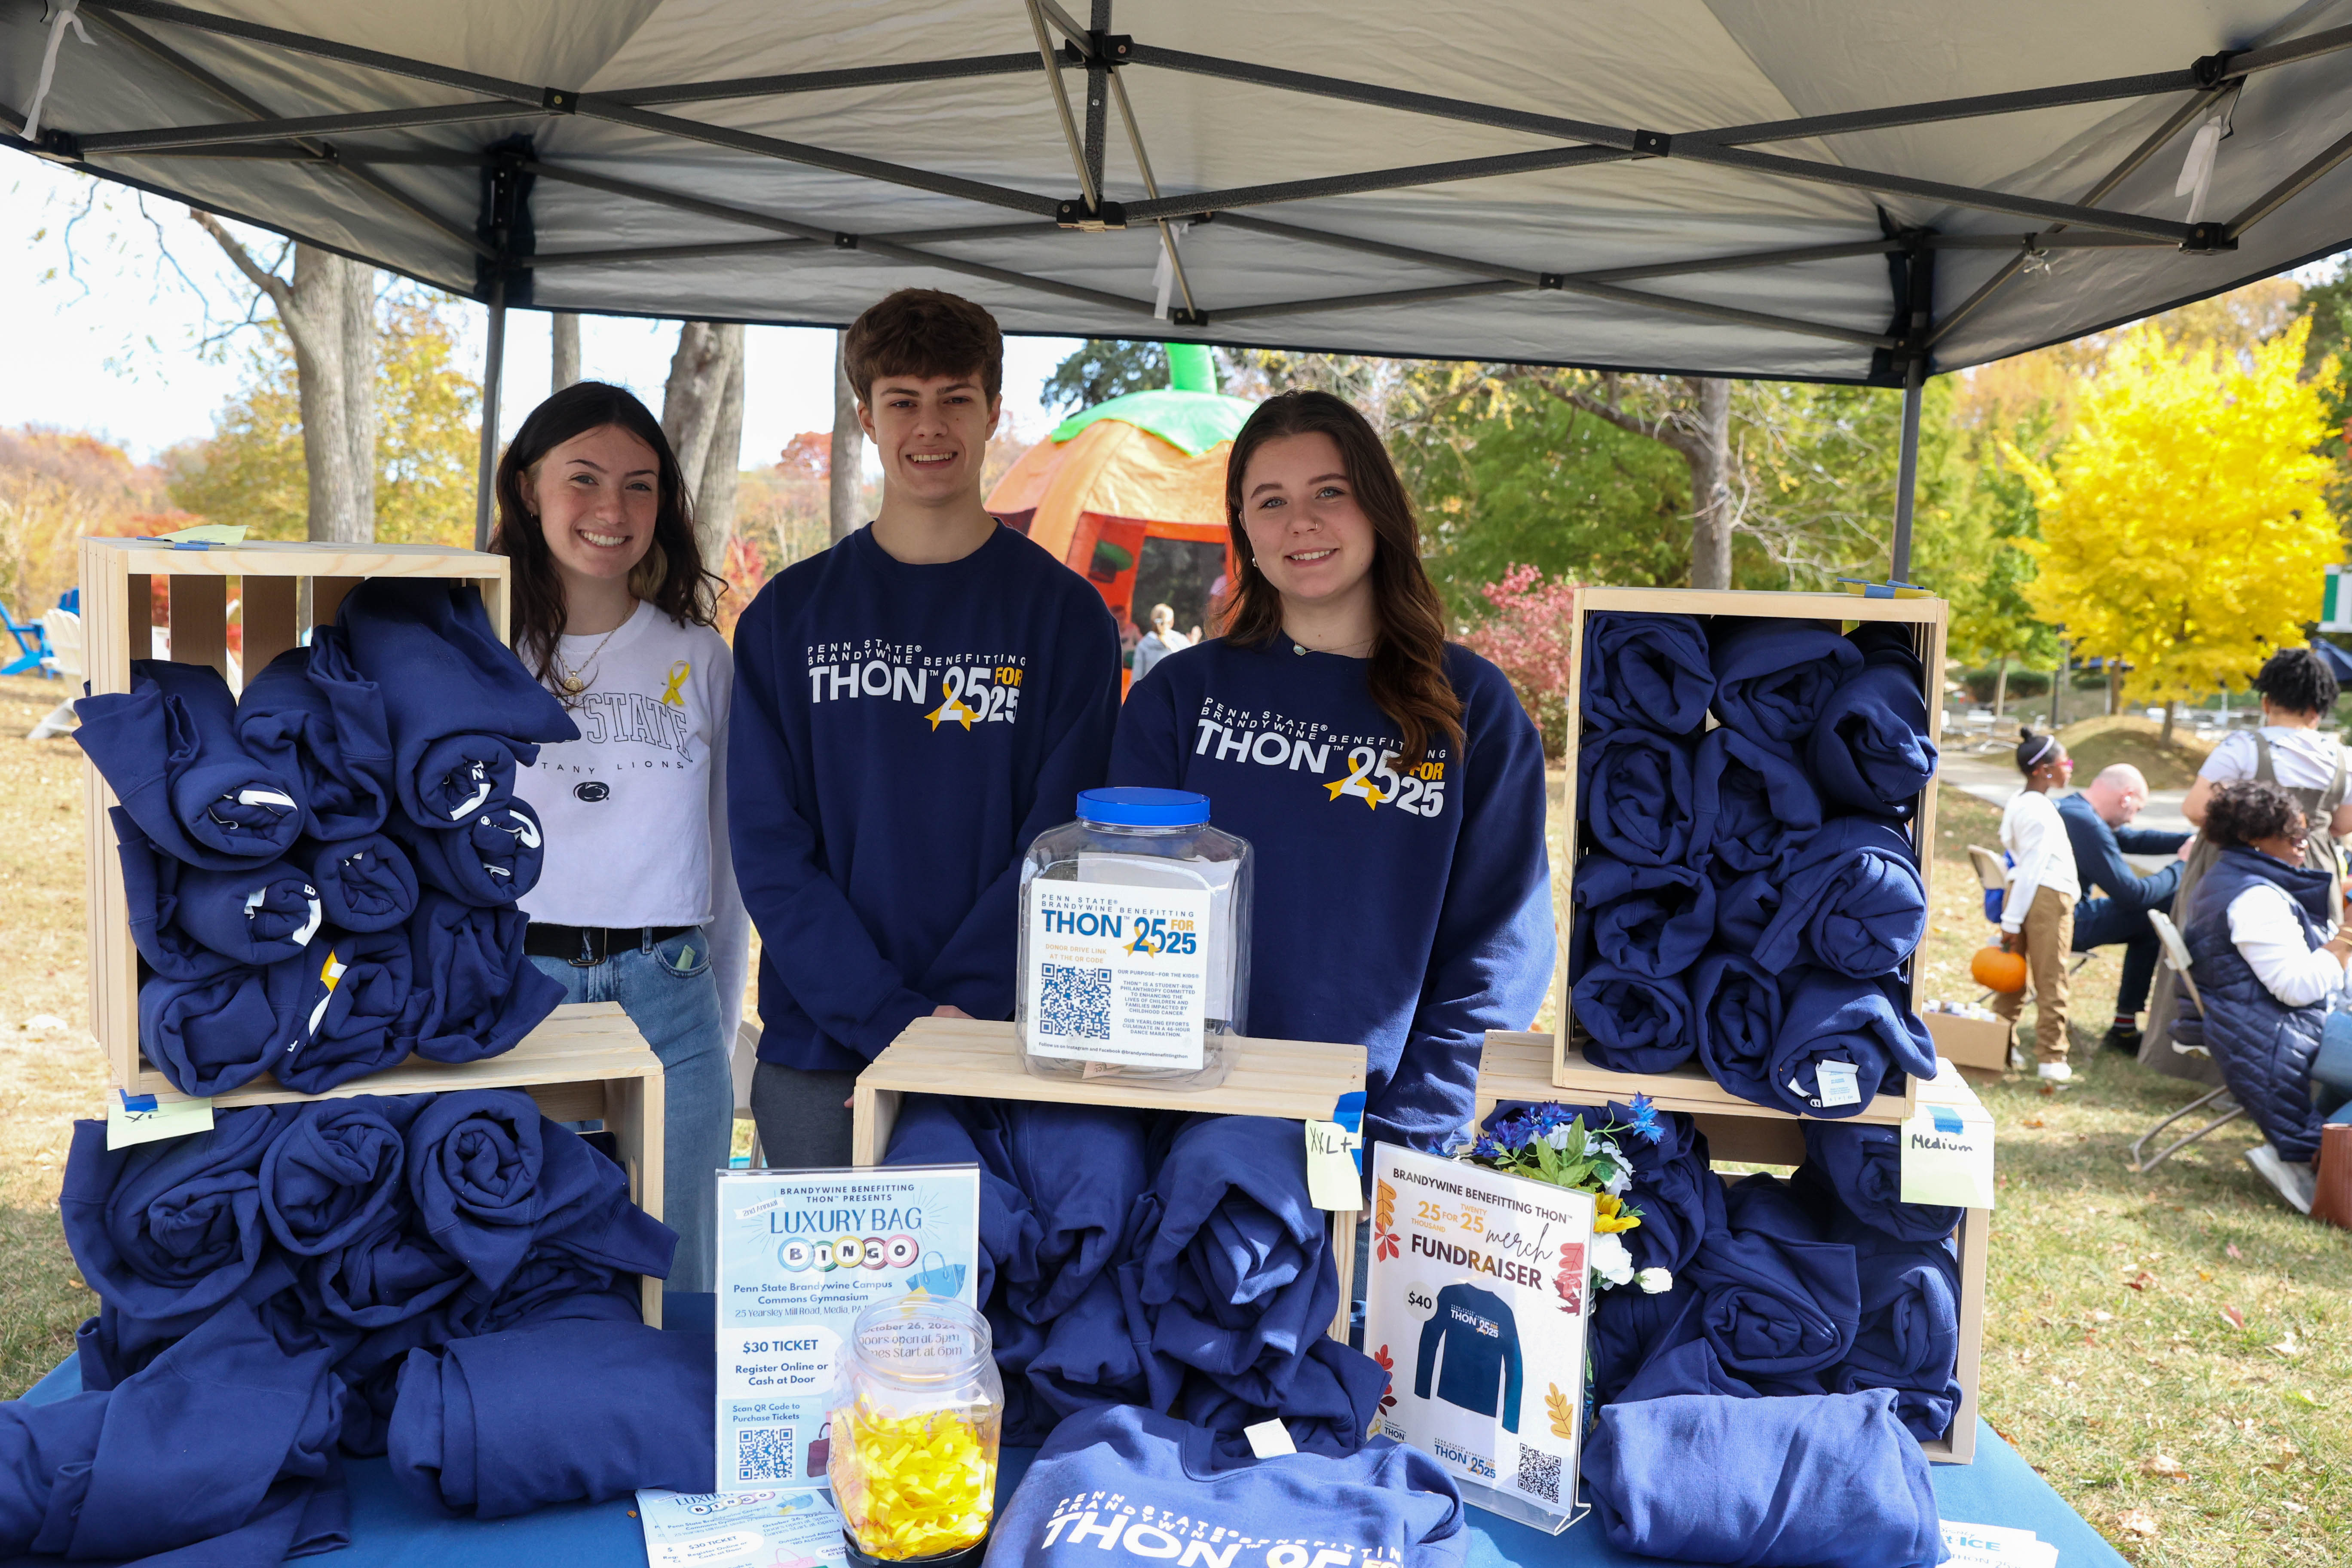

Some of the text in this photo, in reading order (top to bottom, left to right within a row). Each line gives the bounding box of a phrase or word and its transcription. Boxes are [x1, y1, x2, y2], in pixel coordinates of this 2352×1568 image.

[808, 639, 922, 655] PENN STATE®
[808, 649, 1026, 666] BRANDYWINE BENEFITTING
[995, 667, 1023, 687] FOR
[938, 666, 991, 723] 25
[988, 686, 1020, 724] 25
[1204, 697, 1328, 732] PENN STATE®
[583, 692, 691, 762] STATE
[1201, 707, 1446, 758] BRANDYWINE BENEFITNG
[542, 762, 595, 774] TANY
[1339, 747, 1402, 804] 25
[1396, 776, 1445, 817] 25
[1042, 901, 1194, 917] BRANDYWINE BENEFITTING
[1171, 919, 1194, 931] FOR
[1133, 917, 1166, 953] 25
[1166, 931, 1196, 954] 25
[1911, 1134, 1973, 1152] Medium
[781, 1184, 915, 1195] BRANDYWINE BENEFITTING
[843, 1194, 892, 1202] PRESENTS
[1393, 1168, 1463, 1196] BRANDYWINE
[1466, 1188, 1532, 1214] BENEFITTING
[742, 1199, 778, 1217] 2nd Annual
[1461, 1203, 1488, 1216] TWENTY
[771, 1207, 922, 1234] LUXURY BAG
[1411, 1218, 1446, 1233] THOUSAND
[1418, 1201, 1484, 1233] 25 FOR 25
[1485, 1222, 1553, 1264] merch
[1411, 1234, 1543, 1290] FUNDRAISER
[734, 1280, 892, 1292] Penn State Brandywine Campus
[758, 1293, 868, 1304] Commons Gymnasium
[1408, 1291, 1432, 1309] $40
[748, 1308, 783, 1317] Yearsley
[784, 1307, 798, 1316] Mill
[799, 1306, 822, 1315] Road,
[824, 1305, 850, 1315] Media,
[922, 1335, 932, 1343] at
[935, 1334, 959, 1344] 5pm
[1488, 1328, 1499, 1338] 25
[743, 1339, 818, 1354] $30 TICKET
[893, 1347, 921, 1357] Start
[924, 1347, 935, 1356] at
[938, 1347, 962, 1356] 6pm
[735, 1364, 778, 1375] Register
[781, 1363, 814, 1372] Online
[748, 1377, 774, 1386] Cash
[732, 1415, 771, 1423] Purchase
[1471, 1457, 1484, 1474] 25
[1484, 1467, 1496, 1479] 25
[1058, 1491, 1124, 1508] PENN
[1053, 1500, 1222, 1543] BRANDYWINE
[1239, 1537, 1401, 1562] BENEFITTIN
[707, 1536, 737, 1545] TICKET
[1960, 1537, 2000, 1551] ICE
